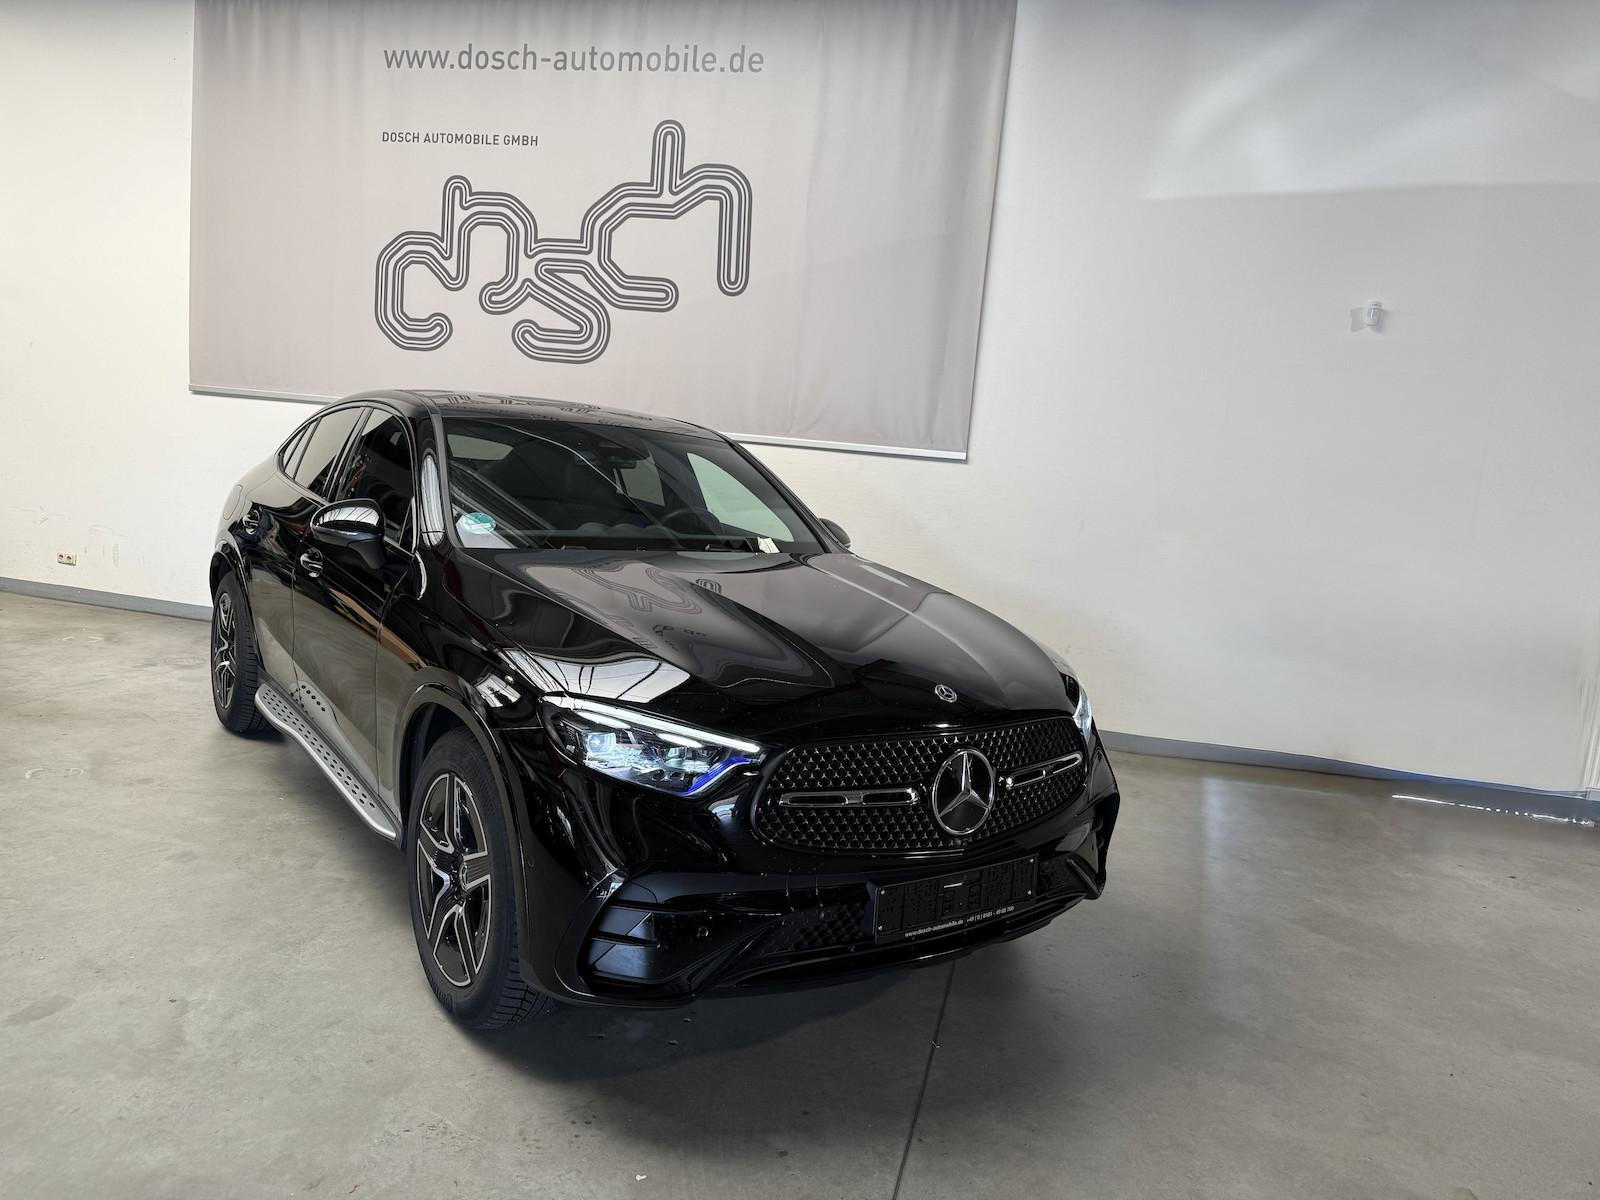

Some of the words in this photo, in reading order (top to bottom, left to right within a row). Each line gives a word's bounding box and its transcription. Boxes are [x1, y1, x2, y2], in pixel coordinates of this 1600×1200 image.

[384, 43, 764, 73] www.dosch-automobile.de
[381, 131, 420, 143] DOSCH
[422, 132, 500, 146] AUTOMOBILE
[503, 134, 539, 147] GMBH
